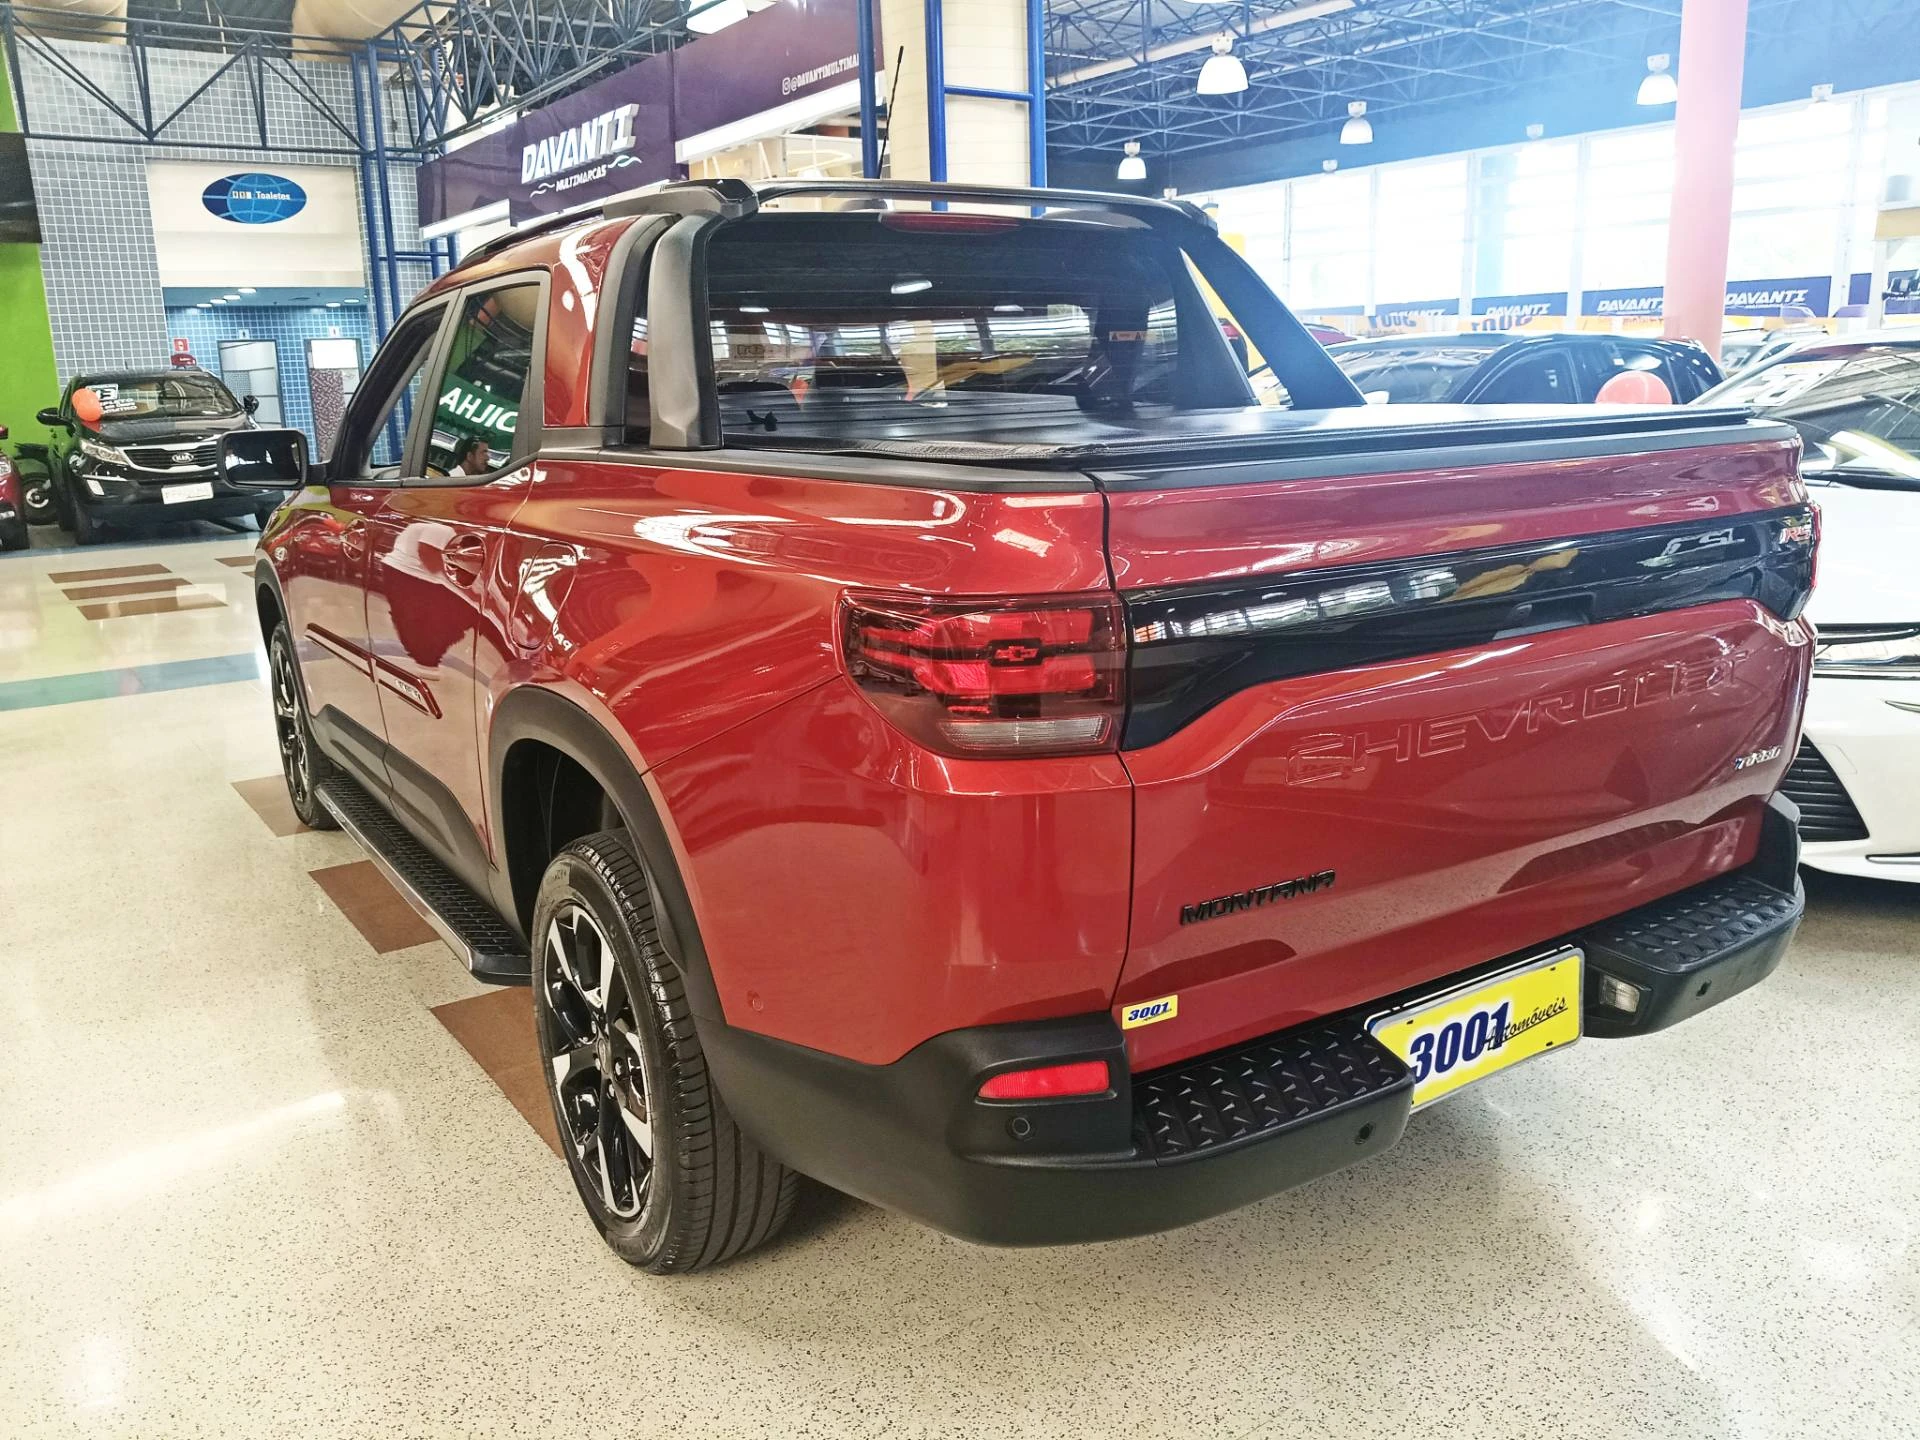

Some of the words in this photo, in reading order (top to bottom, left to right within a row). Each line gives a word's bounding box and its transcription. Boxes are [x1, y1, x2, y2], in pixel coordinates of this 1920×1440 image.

[521, 103, 639, 185] DAVANTI
[555, 164, 607, 192] MULTIMARCAS
[255, 190, 291, 201] Toaletes
[1725, 289, 1809, 306] DAVANTI
[173, 453, 193, 463] KIA
[1780, 526, 1812, 544] RS
[1286, 650, 1748, 786] CHEVROLET
[1734, 745, 1781, 770] TURBO
[1180, 868, 1336, 926] MONTANA
[1128, 1001, 1169, 1021] 3001
[1410, 1001, 1510, 1085] 3001
